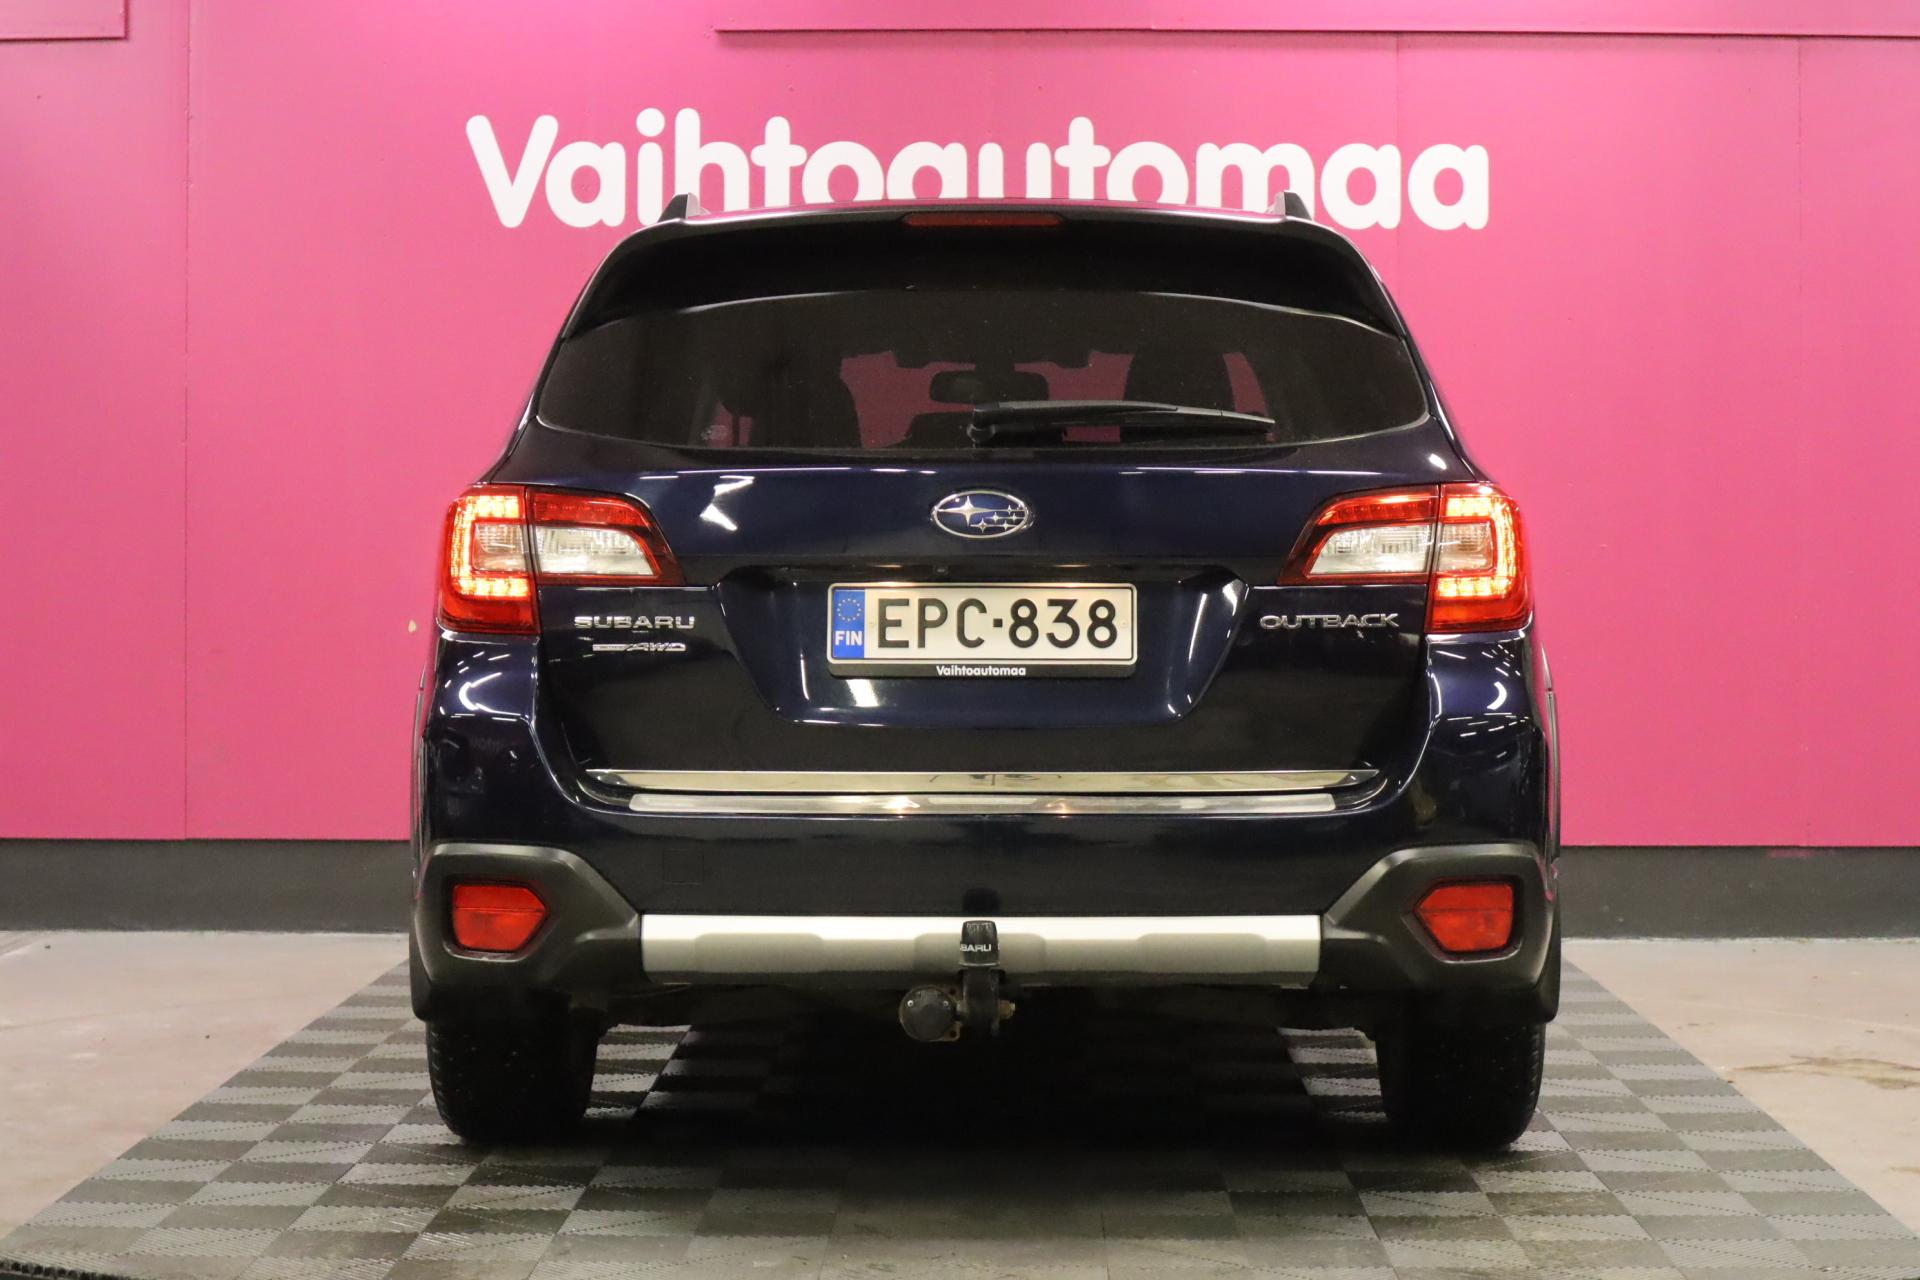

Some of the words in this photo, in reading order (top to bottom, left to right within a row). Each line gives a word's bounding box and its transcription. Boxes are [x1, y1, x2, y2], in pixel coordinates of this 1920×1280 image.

[466, 108, 1489, 230] Vaihtoautomaa
[574, 615, 695, 629] SUBARU
[878, 598, 1118, 648] EPC-838
[1260, 613, 1400, 629] OUTBACK
[835, 630, 862, 646] FIN
[627, 642, 686, 652] AWD
[936, 665, 1026, 676] Vaihtoautomaa
